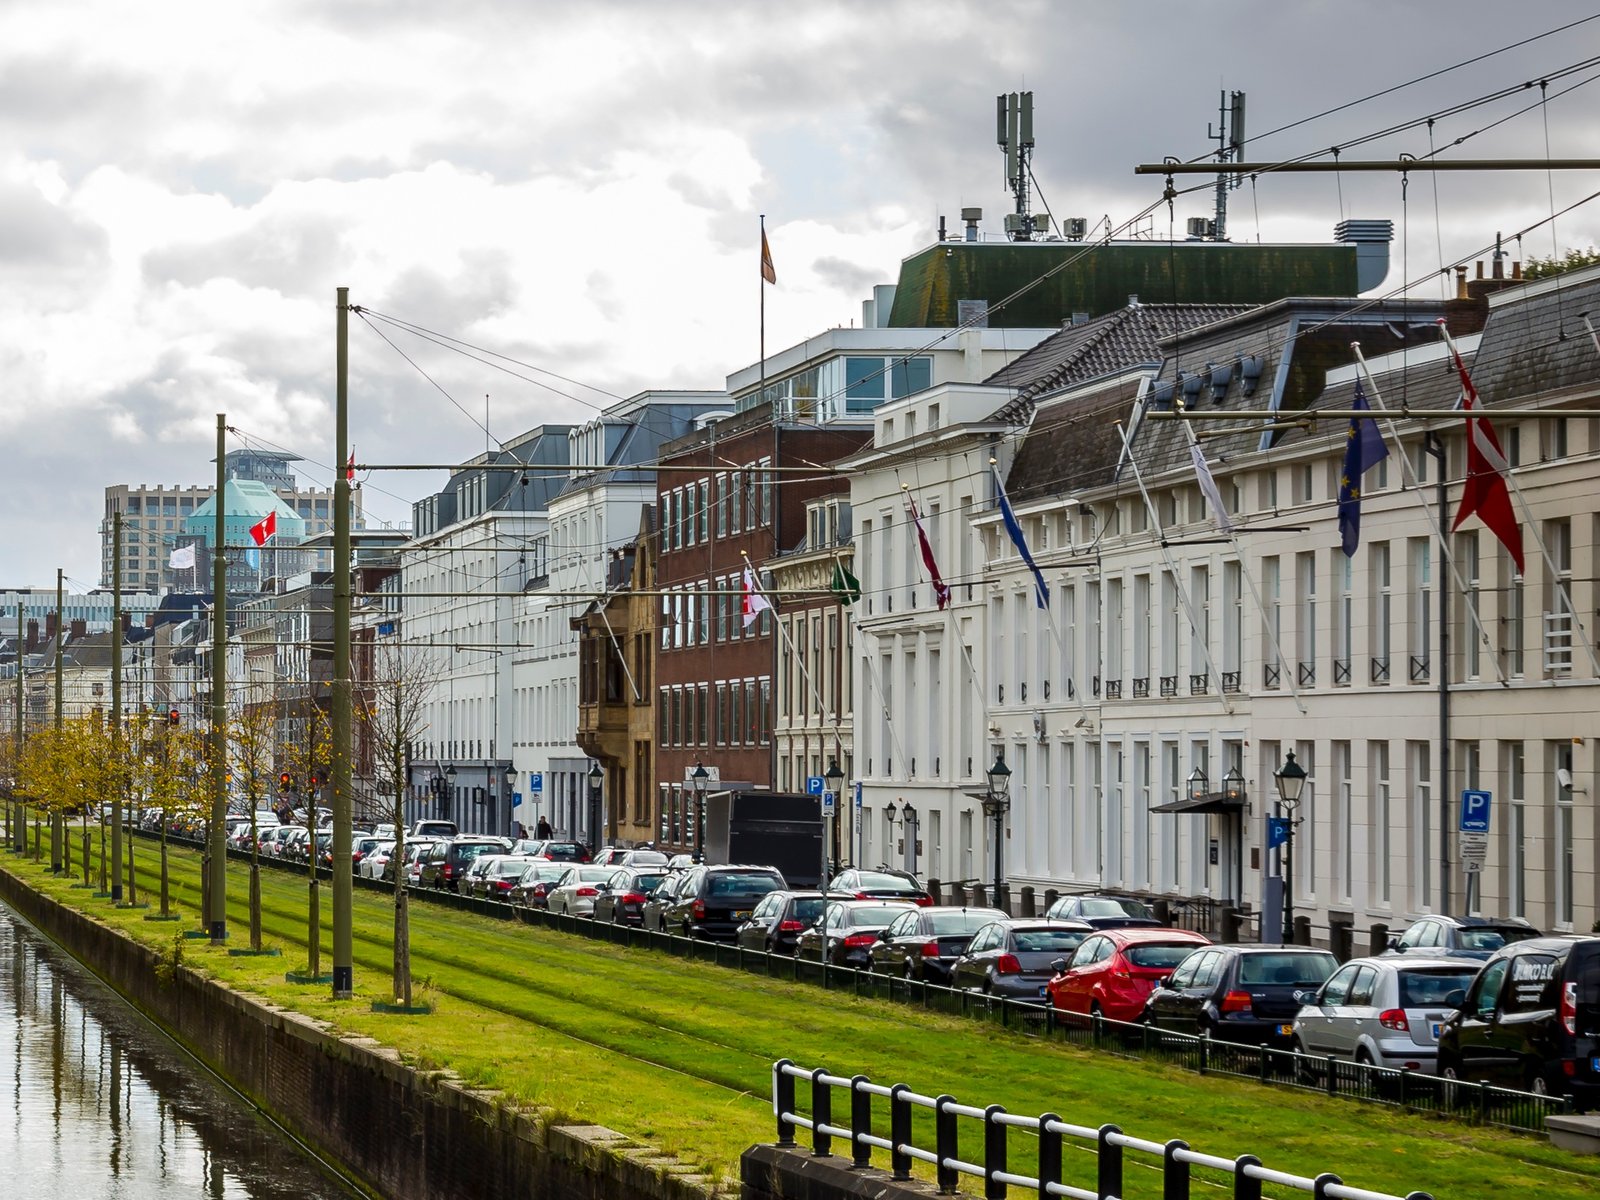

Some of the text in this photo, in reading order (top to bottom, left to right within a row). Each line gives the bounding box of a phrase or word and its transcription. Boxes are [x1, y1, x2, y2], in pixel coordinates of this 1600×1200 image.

[811, 780, 820, 791] P
[1468, 795, 1484, 814] P
[1275, 827, 1283, 839] P
